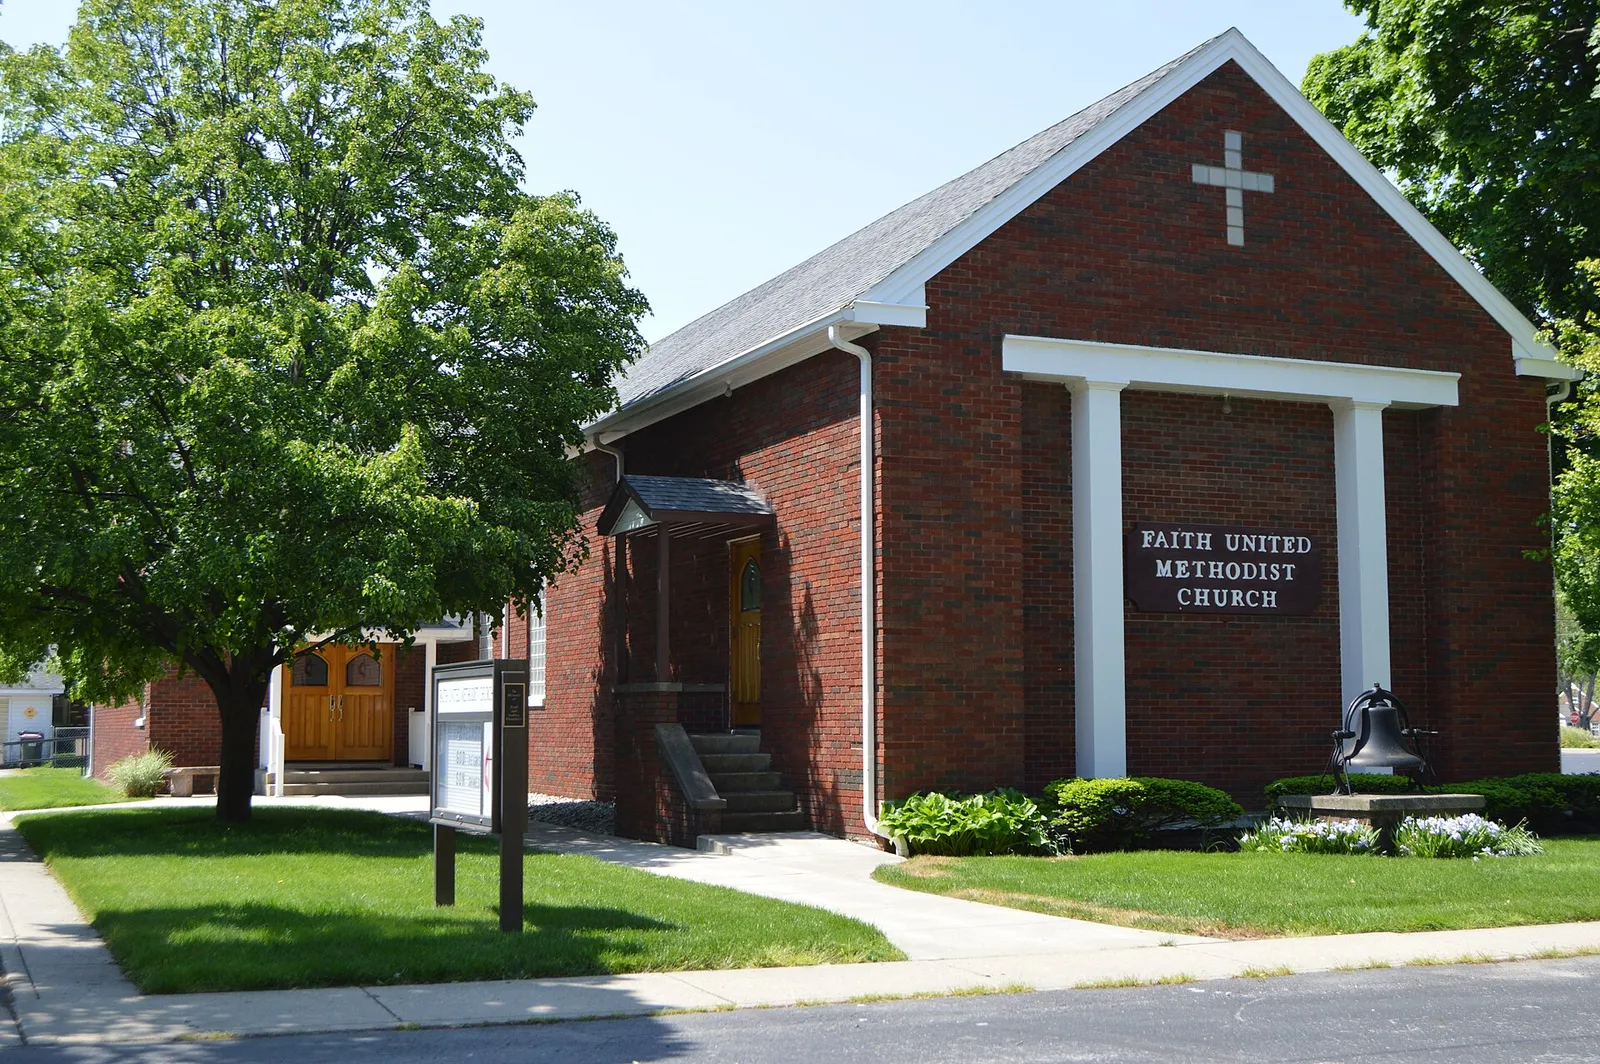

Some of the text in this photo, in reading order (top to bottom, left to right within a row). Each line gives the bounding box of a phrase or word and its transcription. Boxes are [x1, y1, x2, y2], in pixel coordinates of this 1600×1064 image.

[1141, 530, 1312, 554] FAITH UNITED
[1155, 559, 1296, 581] METHODIST
[1177, 587, 1278, 608] CHURCH
